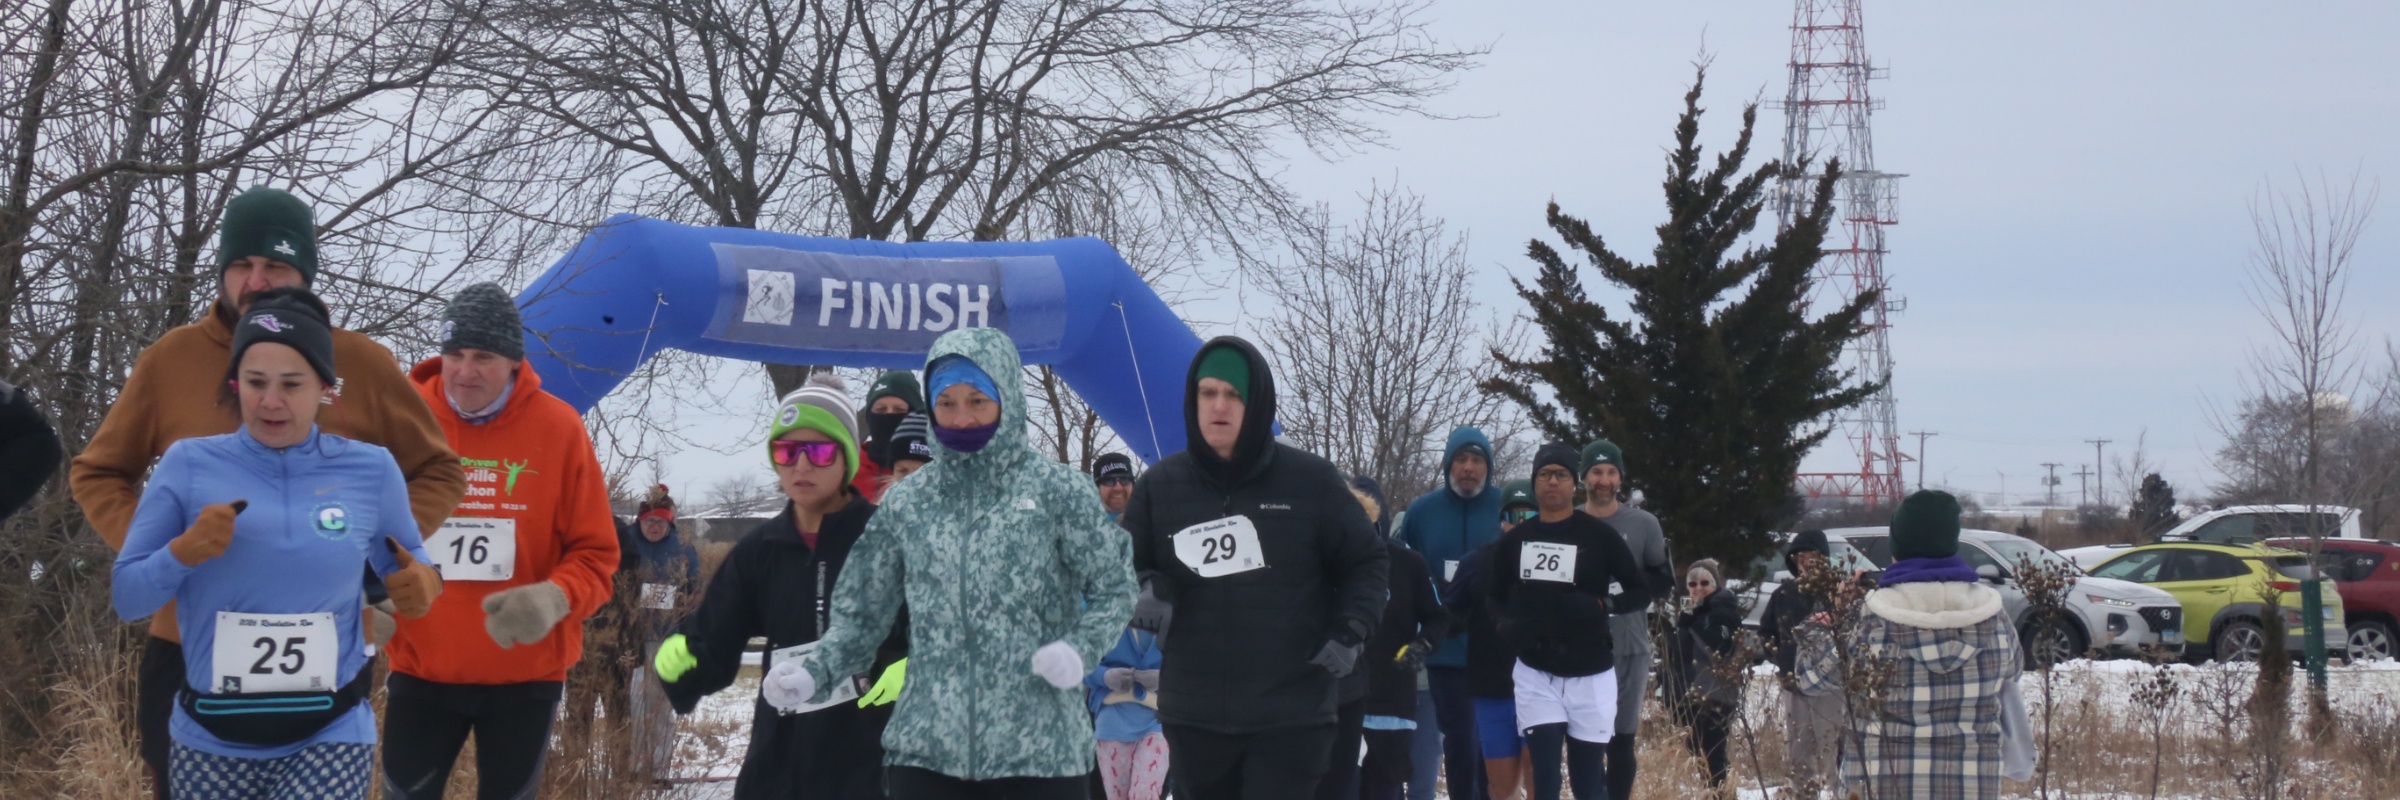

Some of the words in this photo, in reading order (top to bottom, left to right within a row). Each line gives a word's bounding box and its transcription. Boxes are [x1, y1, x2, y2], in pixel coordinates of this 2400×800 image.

[818, 278, 990, 331] FINISH
[450, 535, 490, 565] 16
[1202, 534, 1236, 565] 29
[1534, 553, 1560, 571] 26
[249, 637, 307, 675] 25
